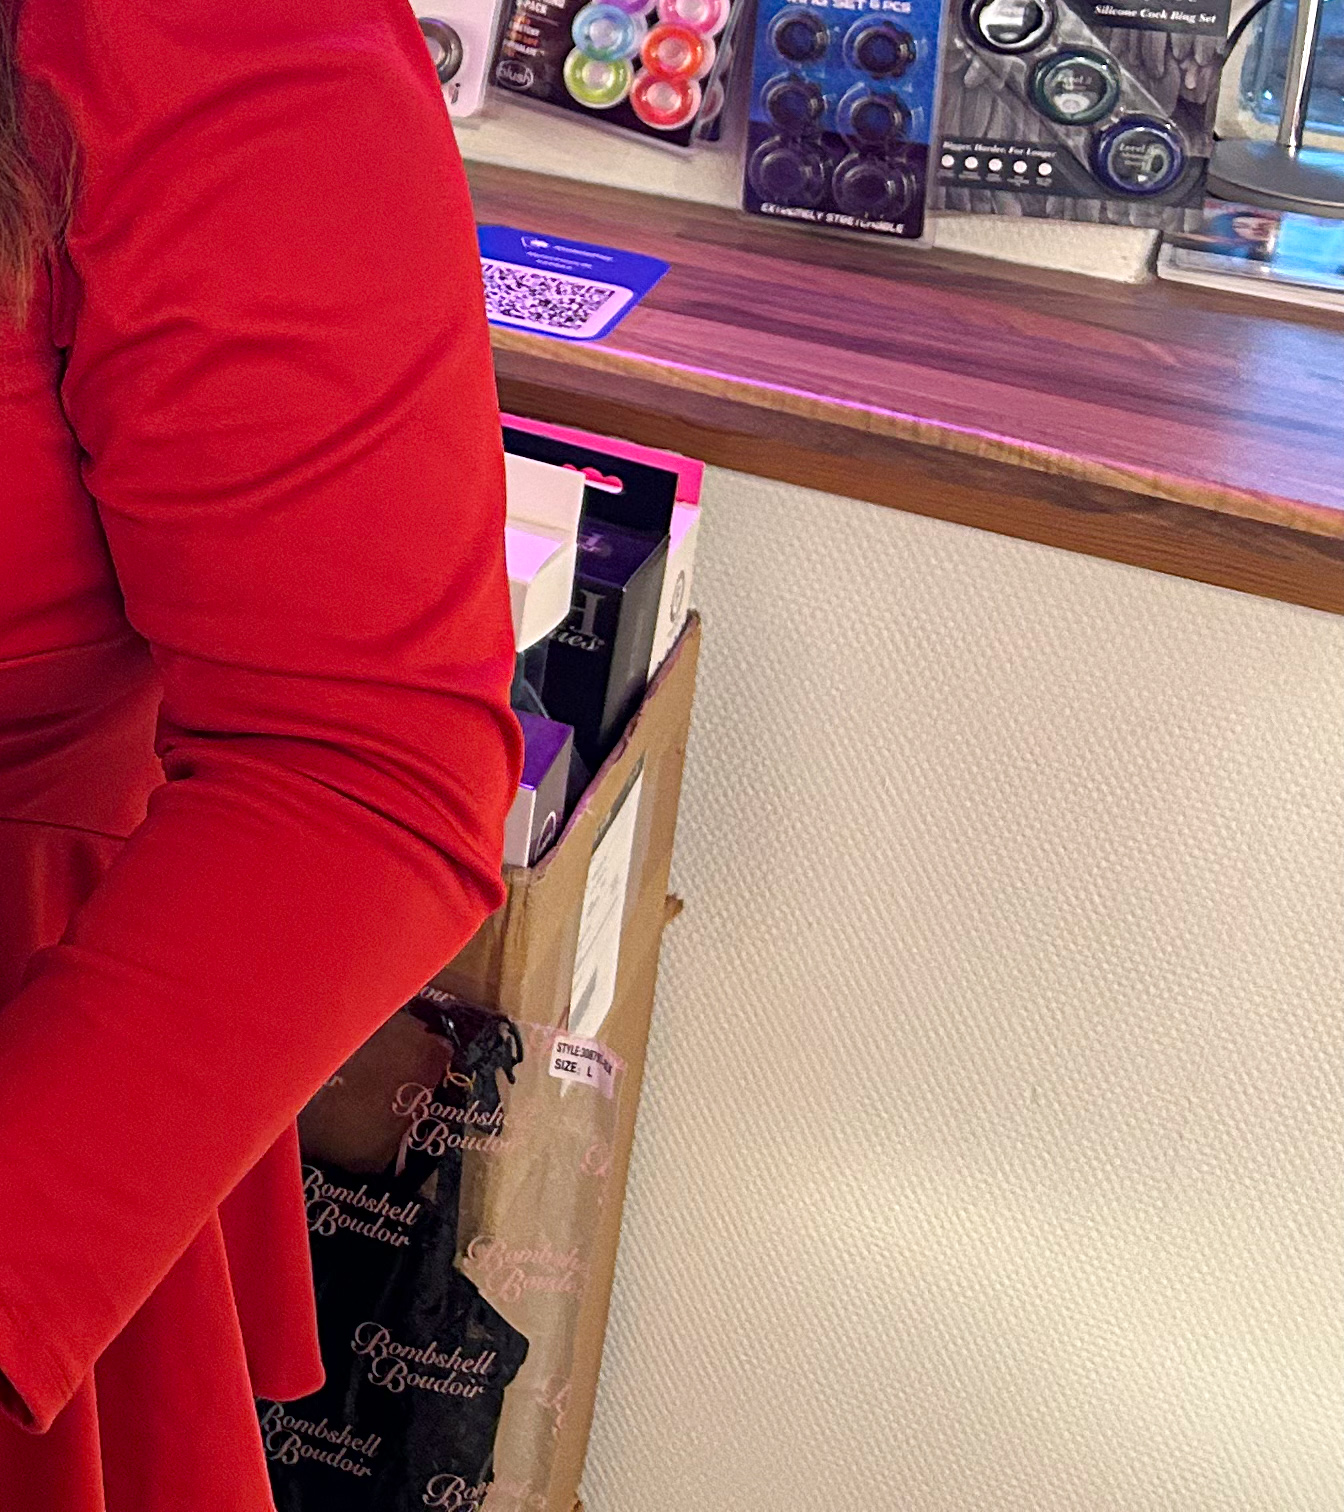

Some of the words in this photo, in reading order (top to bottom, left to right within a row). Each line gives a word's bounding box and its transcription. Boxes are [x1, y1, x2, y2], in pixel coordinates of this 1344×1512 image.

[882, 0, 912, 14] PCS
[1094, 5, 1138, 18] Silicone
[1139, 7, 1167, 20] Cock
[1169, 10, 1197, 24] Ring
[1199, 13, 1217, 24] Set
[586, 1066, 594, 1078] L
[302, 1163, 421, 1227] Bombshell
[305, 1196, 412, 1250] Boudoir
[350, 1320, 498, 1377] Bombshell
[367, 1352, 484, 1400] Boudoir
[264, 1427, 373, 1478] Boudoir
